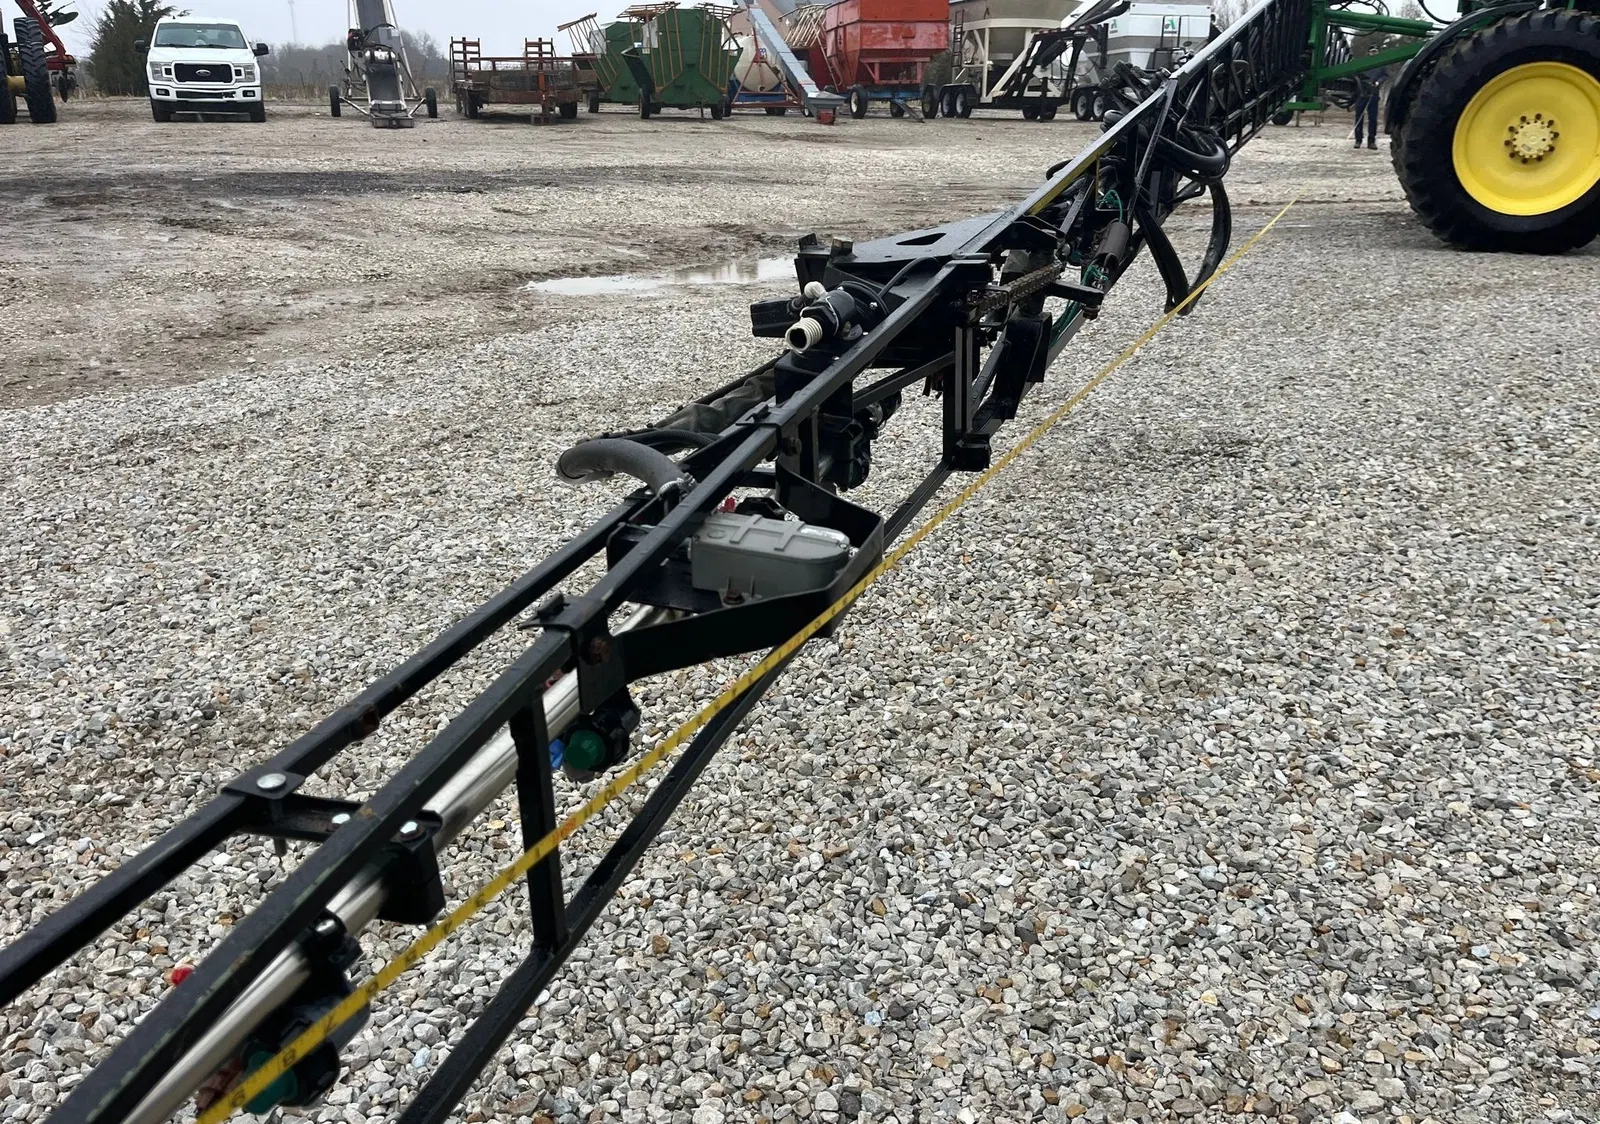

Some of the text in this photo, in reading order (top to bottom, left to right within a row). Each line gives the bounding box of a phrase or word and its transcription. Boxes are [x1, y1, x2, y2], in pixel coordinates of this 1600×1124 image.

[366, 980, 379, 995] 6
[324, 1014, 337, 1035] 7
[282, 1047, 297, 1067] 8
[231, 1088, 246, 1107] 9
